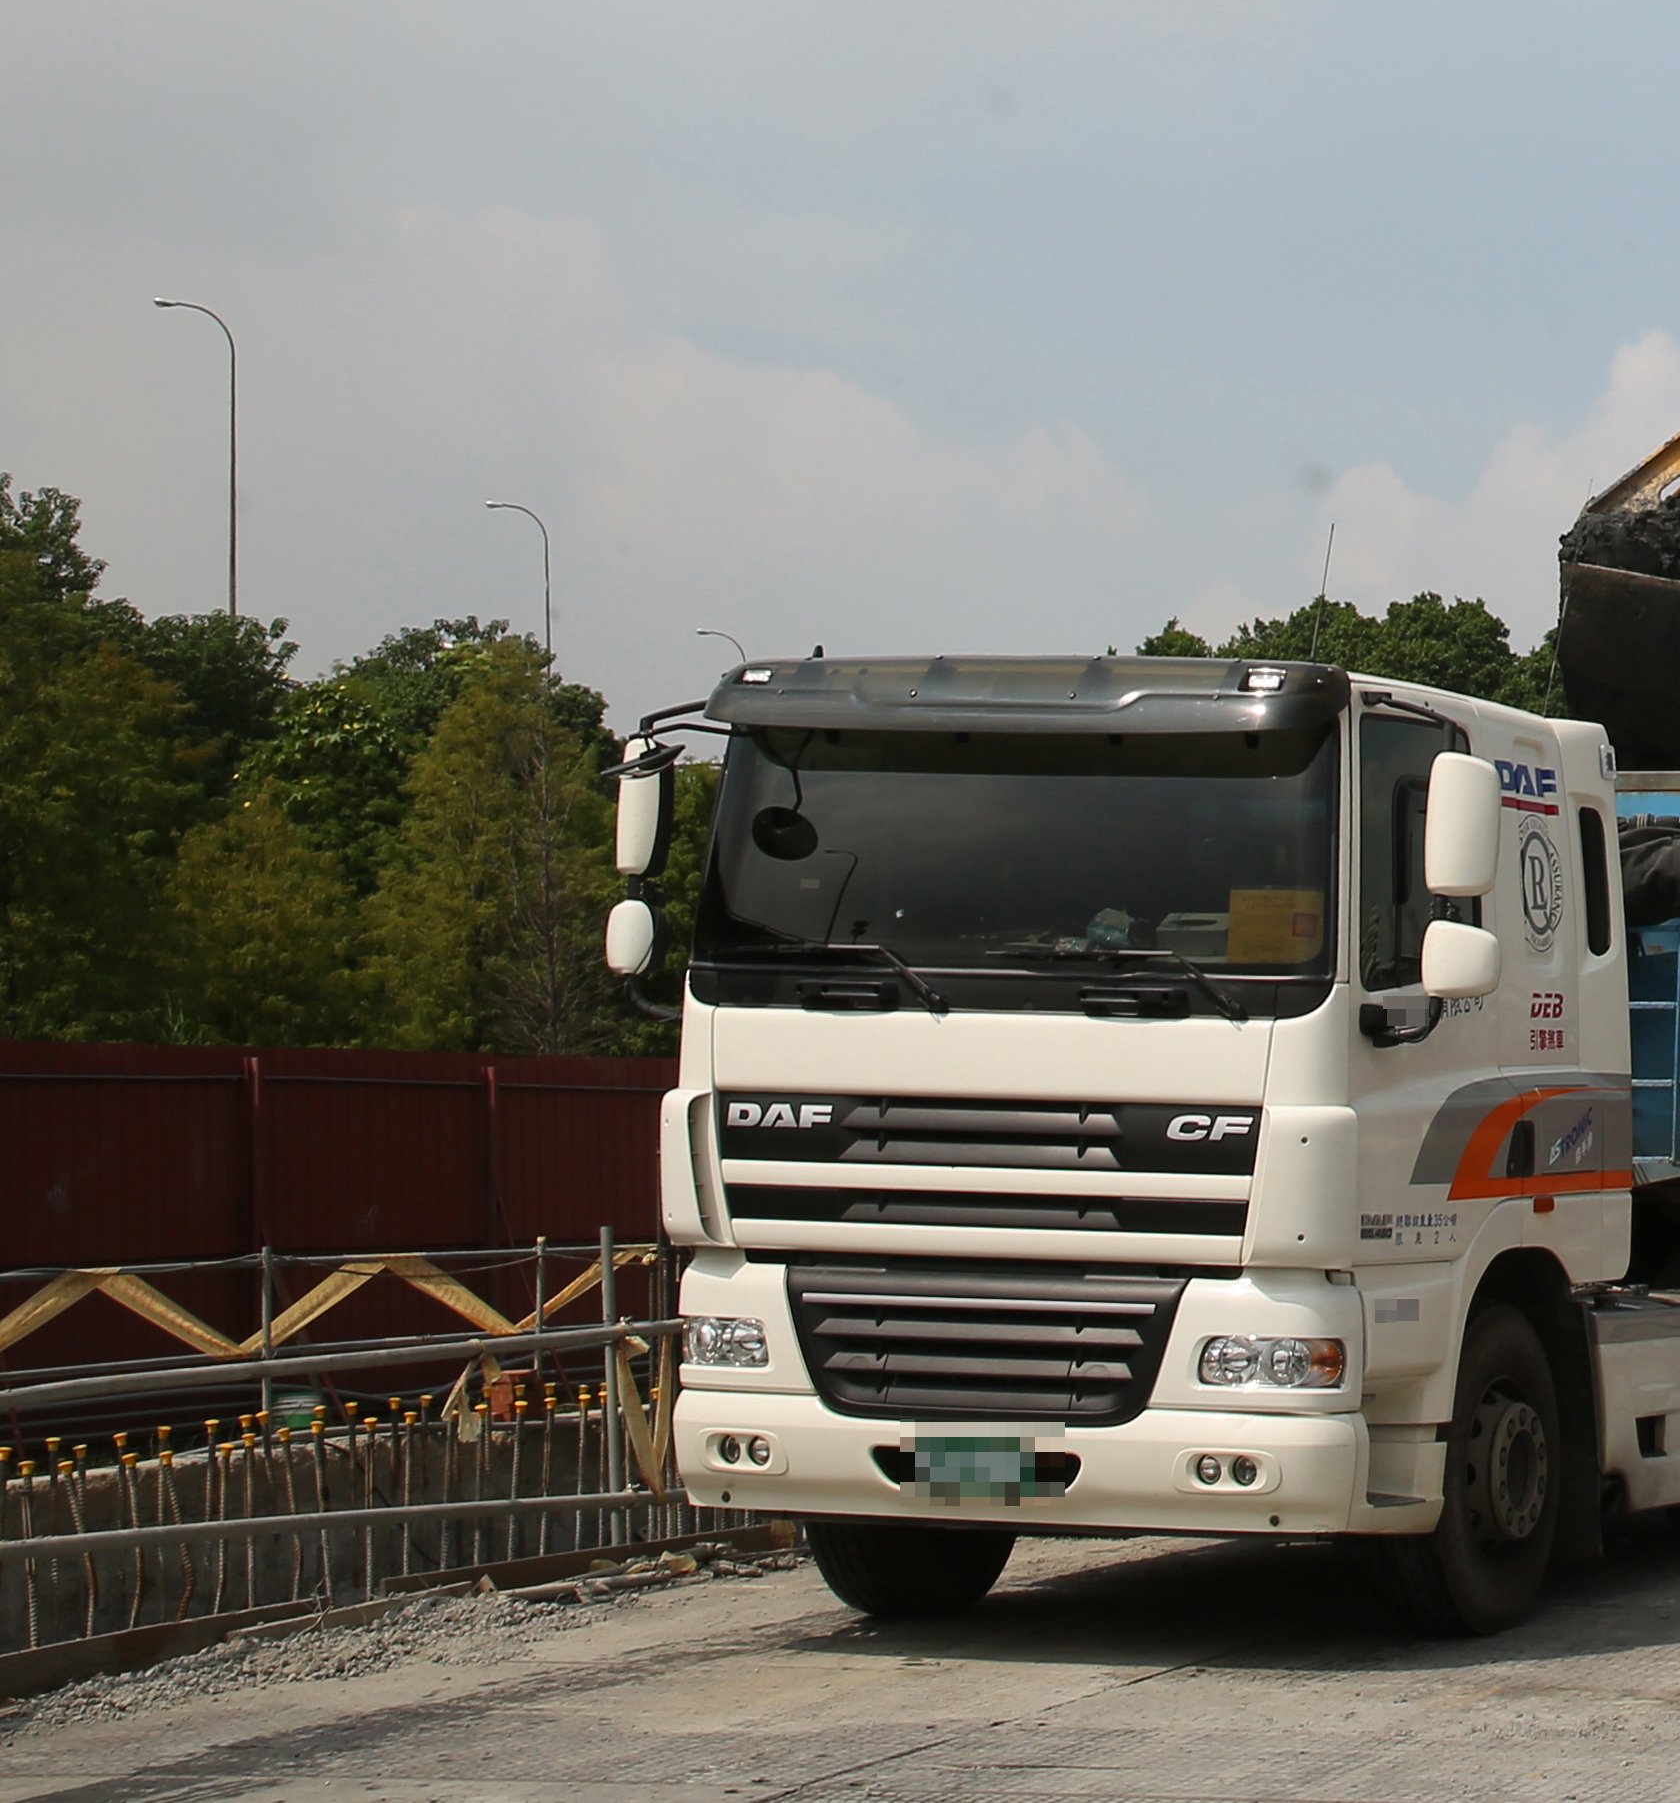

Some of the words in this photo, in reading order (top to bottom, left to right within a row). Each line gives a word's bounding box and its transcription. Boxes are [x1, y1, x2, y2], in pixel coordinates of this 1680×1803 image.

[1494, 759, 1557, 798] DAF
[1530, 992, 1564, 1019] DEB
[726, 1101, 834, 1129] DAF
[1165, 1114, 1255, 1142] CF
